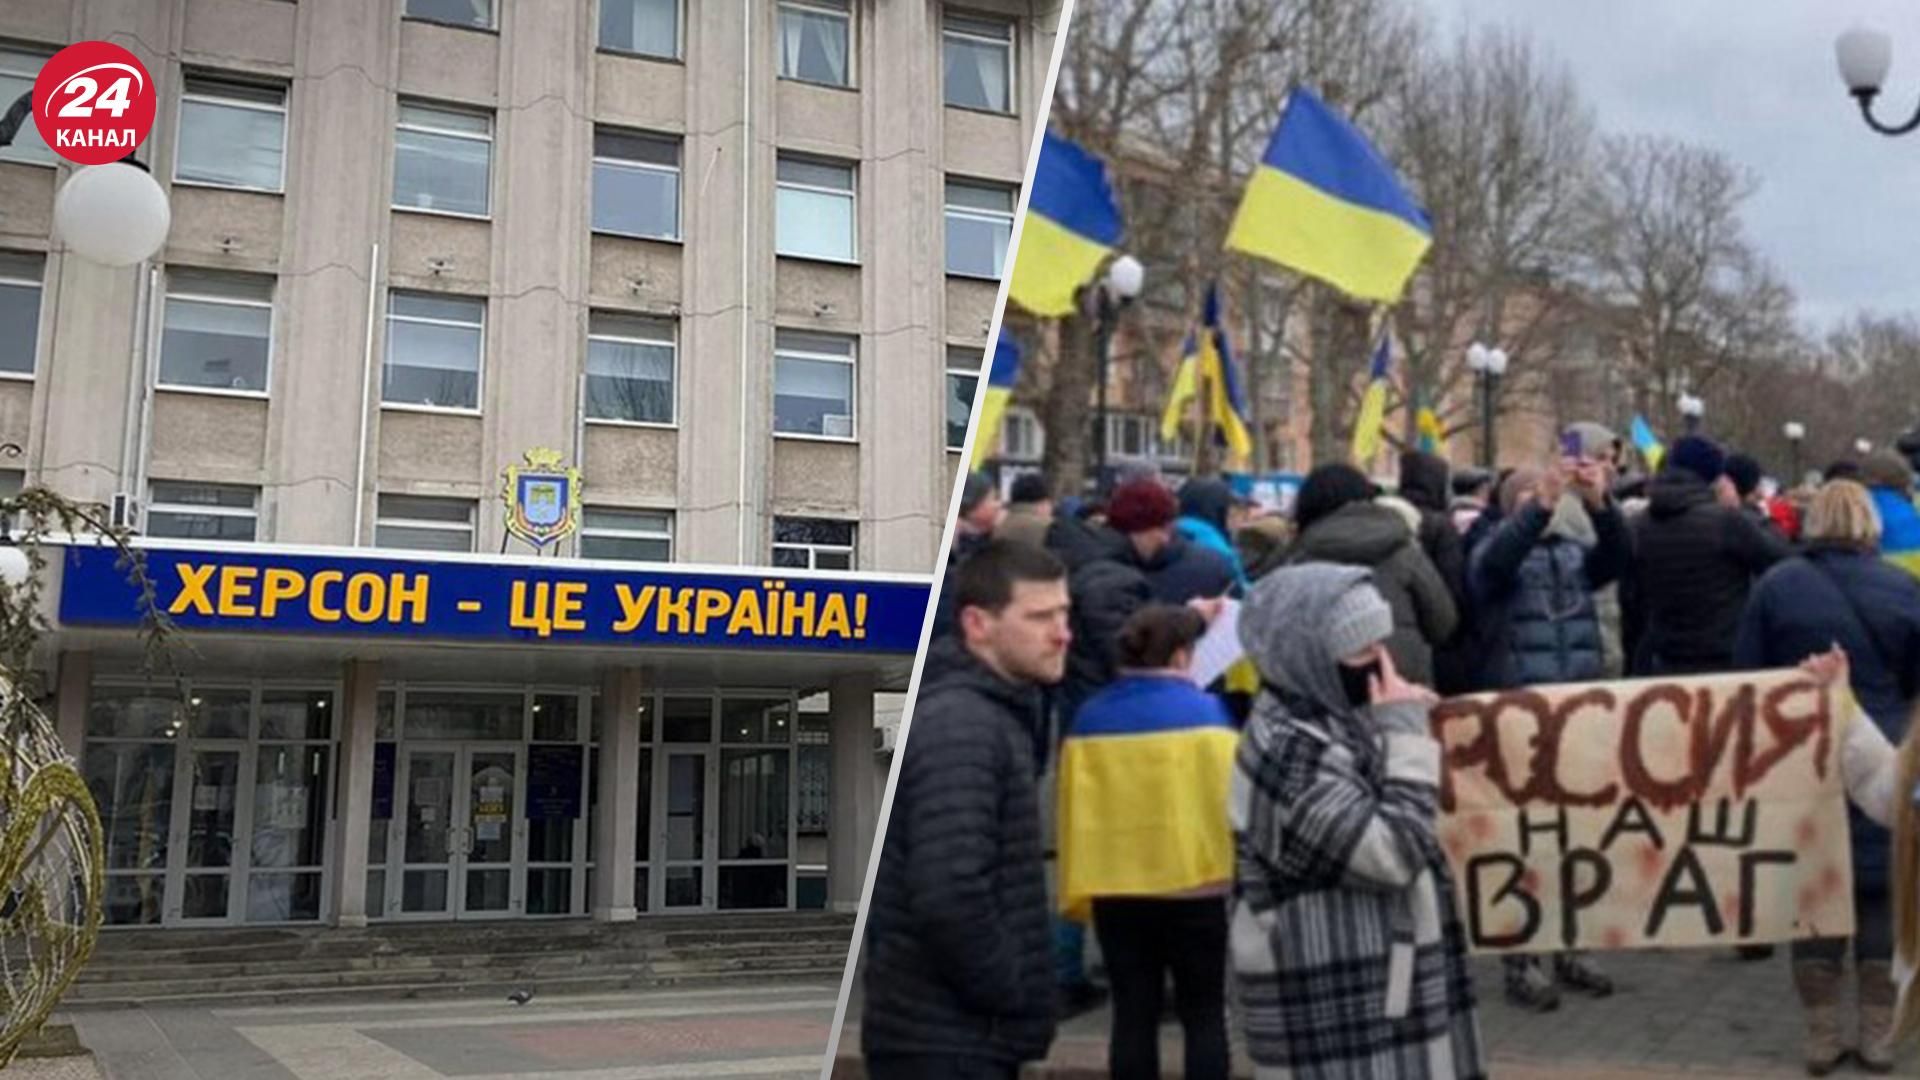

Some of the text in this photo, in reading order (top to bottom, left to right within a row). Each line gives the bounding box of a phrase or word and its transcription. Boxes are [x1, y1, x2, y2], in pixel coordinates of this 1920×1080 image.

[170, 563, 429, 623] ХЕРСОН
[510, 582, 587, 636] ЦЕ
[613, 580, 868, 638] УКРАЇНА!
[1432, 684, 1831, 811] РОССИЯ
[1519, 797, 1757, 856] НАШ
[1466, 845, 1796, 946] ВРАГ
